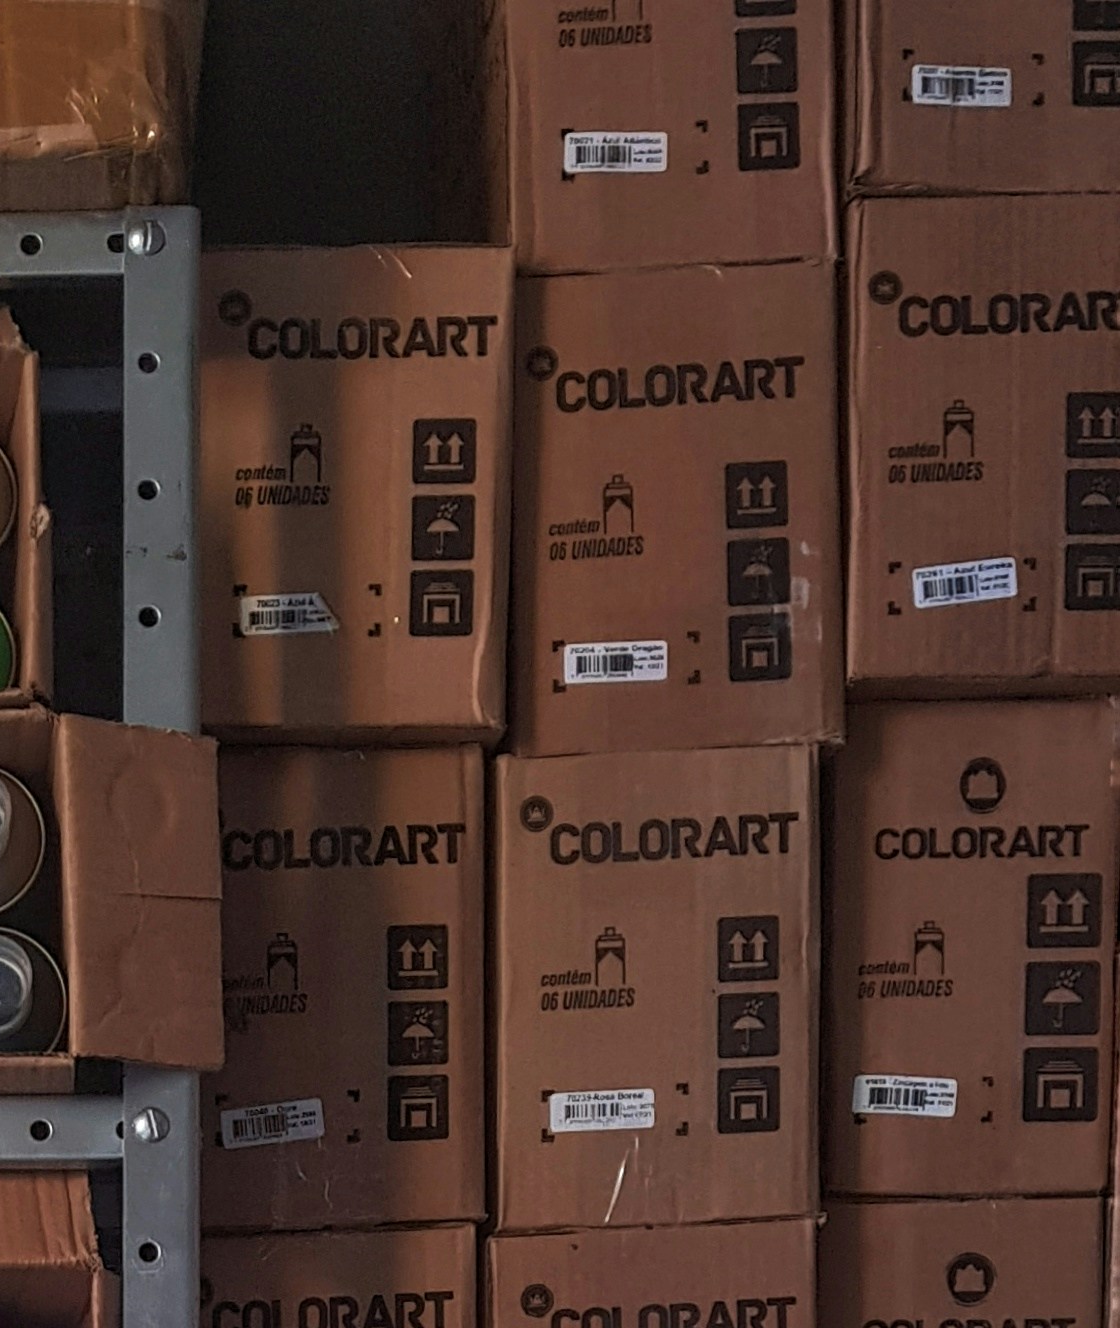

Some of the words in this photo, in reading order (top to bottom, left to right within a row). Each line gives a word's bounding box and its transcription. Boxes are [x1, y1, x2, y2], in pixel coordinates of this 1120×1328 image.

[558, 7, 608, 23] contém
[558, 29, 575, 48] 06
[580, 24, 652, 47] UNIDADES
[898, 292, 1120, 337] COLORAR
[247, 315, 498, 360] COLORART
[555, 356, 805, 413] COLORART
[888, 443, 940, 459] contém
[235, 464, 286, 480] contém
[888, 464, 907, 483] 06
[911, 461, 984, 483] UNIDADES
[235, 486, 253, 506] 06
[257, 485, 330, 506] UNIDADES
[549, 519, 600, 536] contém
[549, 542, 567, 561] 06
[571, 535, 644, 560] UNIDADES
[222, 823, 466, 871] COLORART
[550, 811, 799, 865] COLORART
[875, 824, 1090, 860] COLORART
[541, 969, 591, 987] contém
[880, 979, 953, 998] UNIDADES
[541, 992, 559, 1011] 06
[563, 987, 635, 1010] UNIDADES
